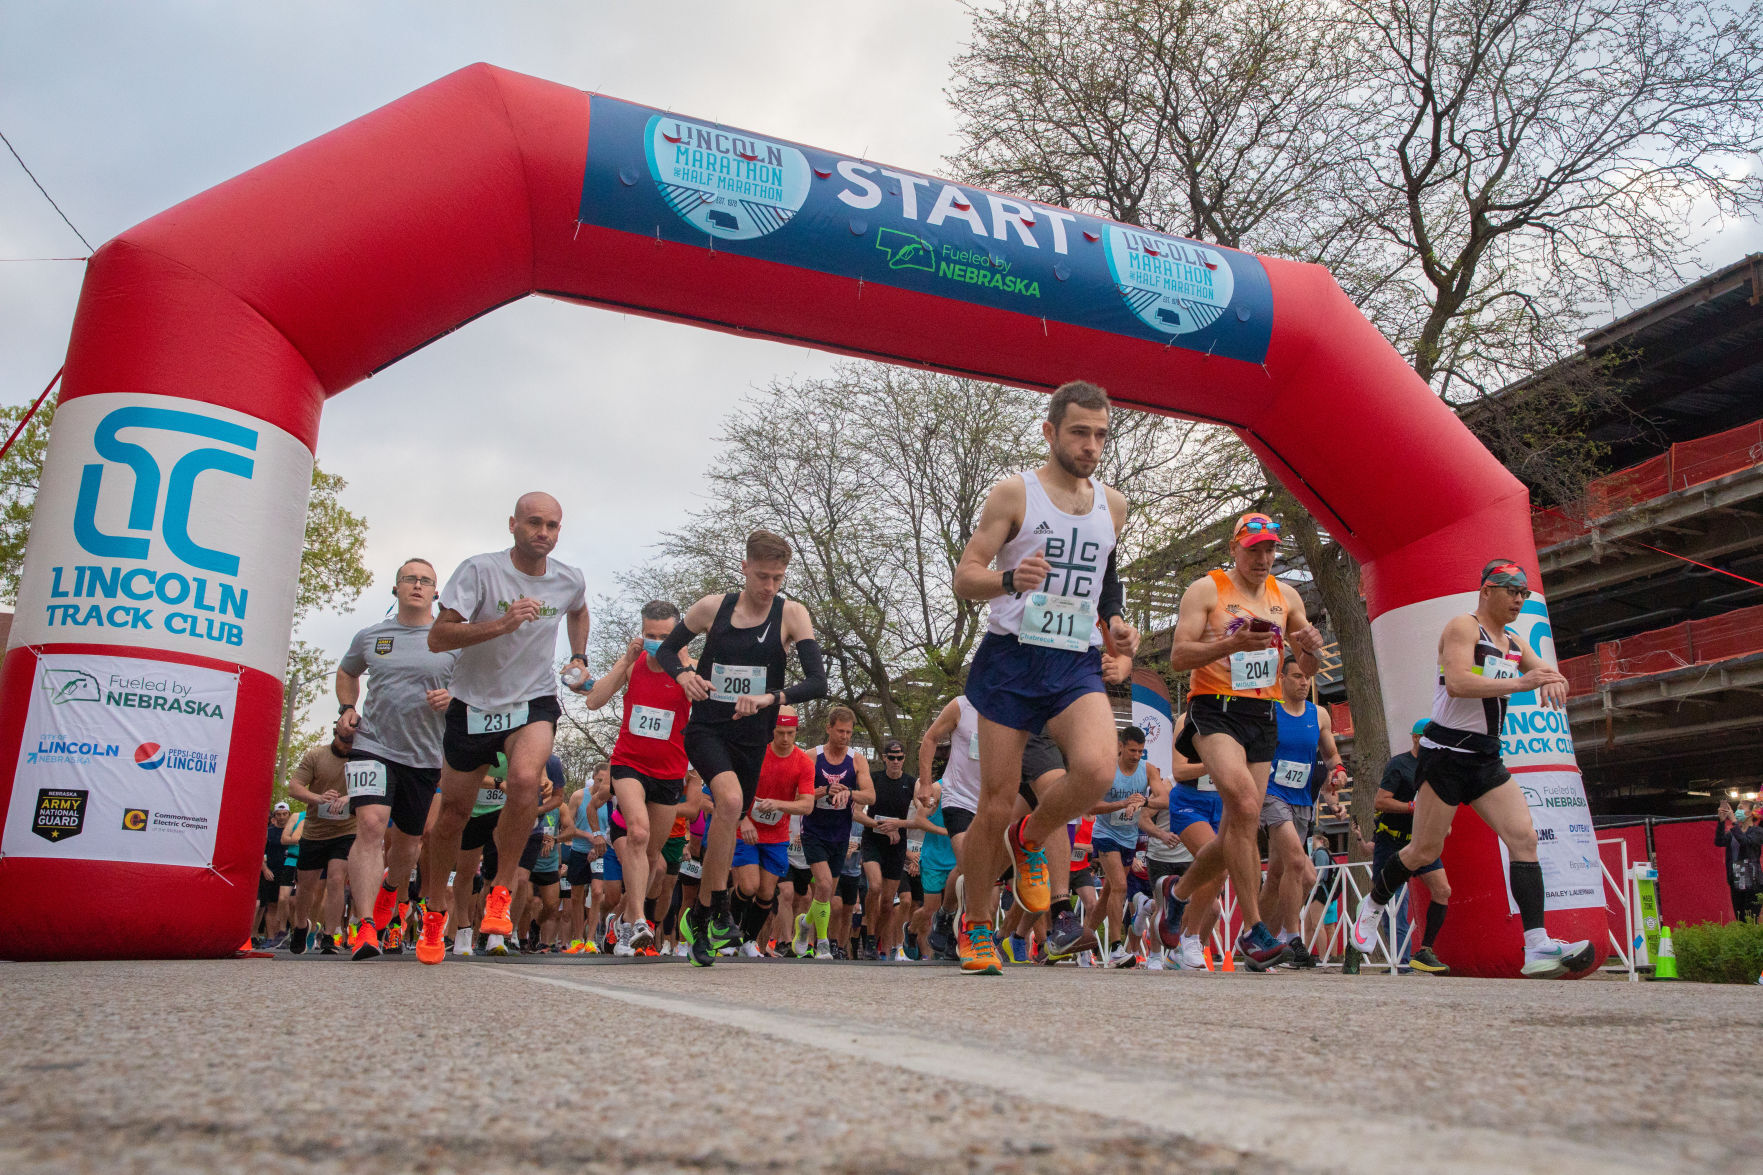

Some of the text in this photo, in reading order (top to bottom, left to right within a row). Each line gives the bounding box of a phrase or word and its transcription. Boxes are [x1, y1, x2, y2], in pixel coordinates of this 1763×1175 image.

[675, 124, 783, 168] LINCOLN
[675, 145, 783, 187] MARATHON
[682, 167, 714, 186] HALF
[717, 175, 783, 202] MARATHON
[837, 160, 1076, 255] START
[942, 244, 1012, 274] Fueled by
[1122, 231, 1209, 268] LINCOLN
[939, 261, 1041, 298] NEBRASKA
[1129, 252, 1213, 287] MARATHON
[1136, 271, 1161, 287] HALF
[1163, 277, 1214, 300] MARATHON
[51, 566, 248, 620] LINCOLN
[46, 604, 244, 647] TRACK CLUB
[1041, 611, 1074, 636] 211
[1246, 660, 1269, 680] 204
[109, 674, 192, 698] Fueled by
[724, 677, 750, 694] 208
[106, 691, 224, 719] NEBRASKA
[484, 712, 511, 732] 231
[639, 715, 662, 731] 215
[1501, 710, 1571, 736] INCOL
[38, 741, 119, 757] LINCOLN
[168, 748, 208, 760] PEPSI-COLA
[1499, 737, 1574, 757] RACK CLU
[39, 755, 91, 765] NEBRASKA
[167, 756, 217, 774] LINCOLN
[1285, 769, 1303, 783] 472
[486, 790, 504, 800] 362
[1543, 786, 1577, 797] Fueled by
[40, 809, 79, 817] NATIONAL
[41, 799, 81, 810] ARMY
[38, 816, 79, 826] GUARD
[153, 819, 180, 827] Electric
[154, 812, 208, 823] Commonwealth
[760, 811, 776, 821] 281
[686, 863, 700, 874] 386
[1545, 890, 1568, 898] BAILEY
